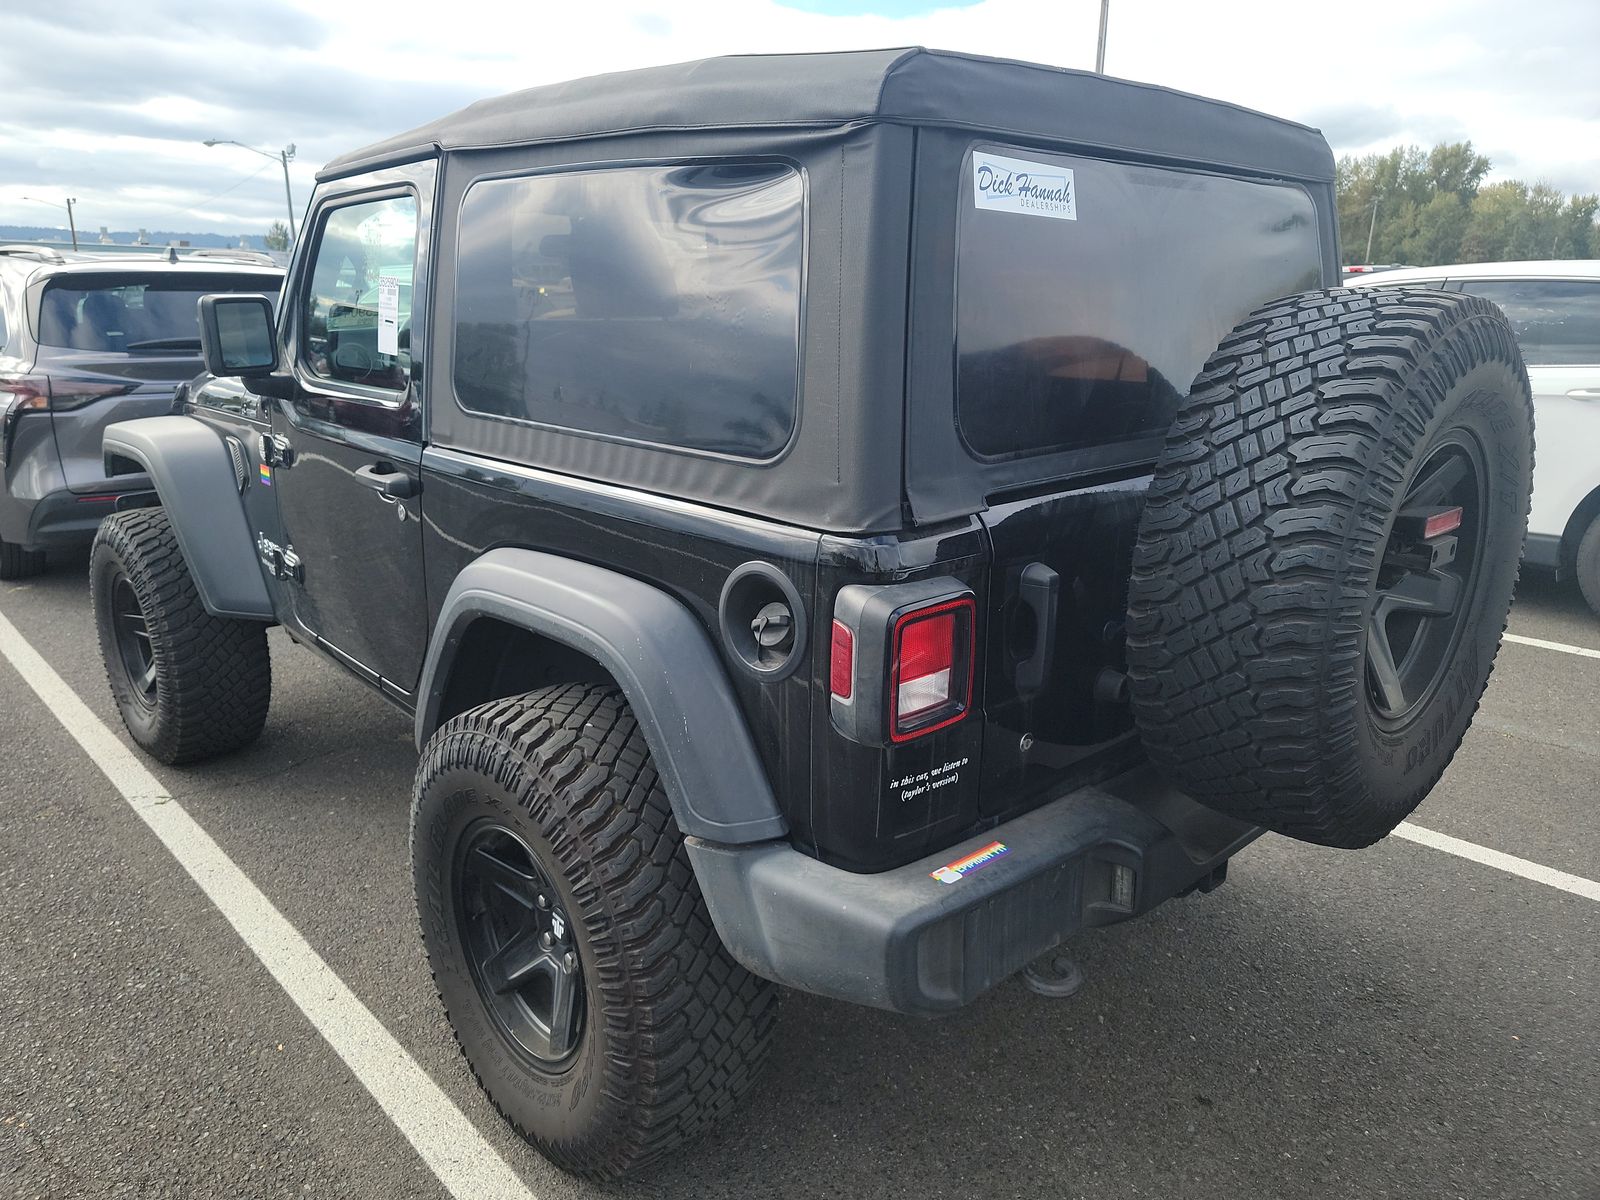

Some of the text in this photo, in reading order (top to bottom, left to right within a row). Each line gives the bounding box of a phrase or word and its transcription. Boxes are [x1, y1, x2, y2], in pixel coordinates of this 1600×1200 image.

[977, 166, 1071, 204] Dick Hannah
[1020, 199, 1071, 214] DEALERSHIPS
[889, 779, 900, 790] in
[900, 774, 915, 787] this
[931, 767, 942, 777] we
[942, 760, 961, 774] listen
[961, 757, 969, 766] to
[901, 772, 959, 802] (taylor's version)
[955, 851, 994, 873] EPIPHANY
